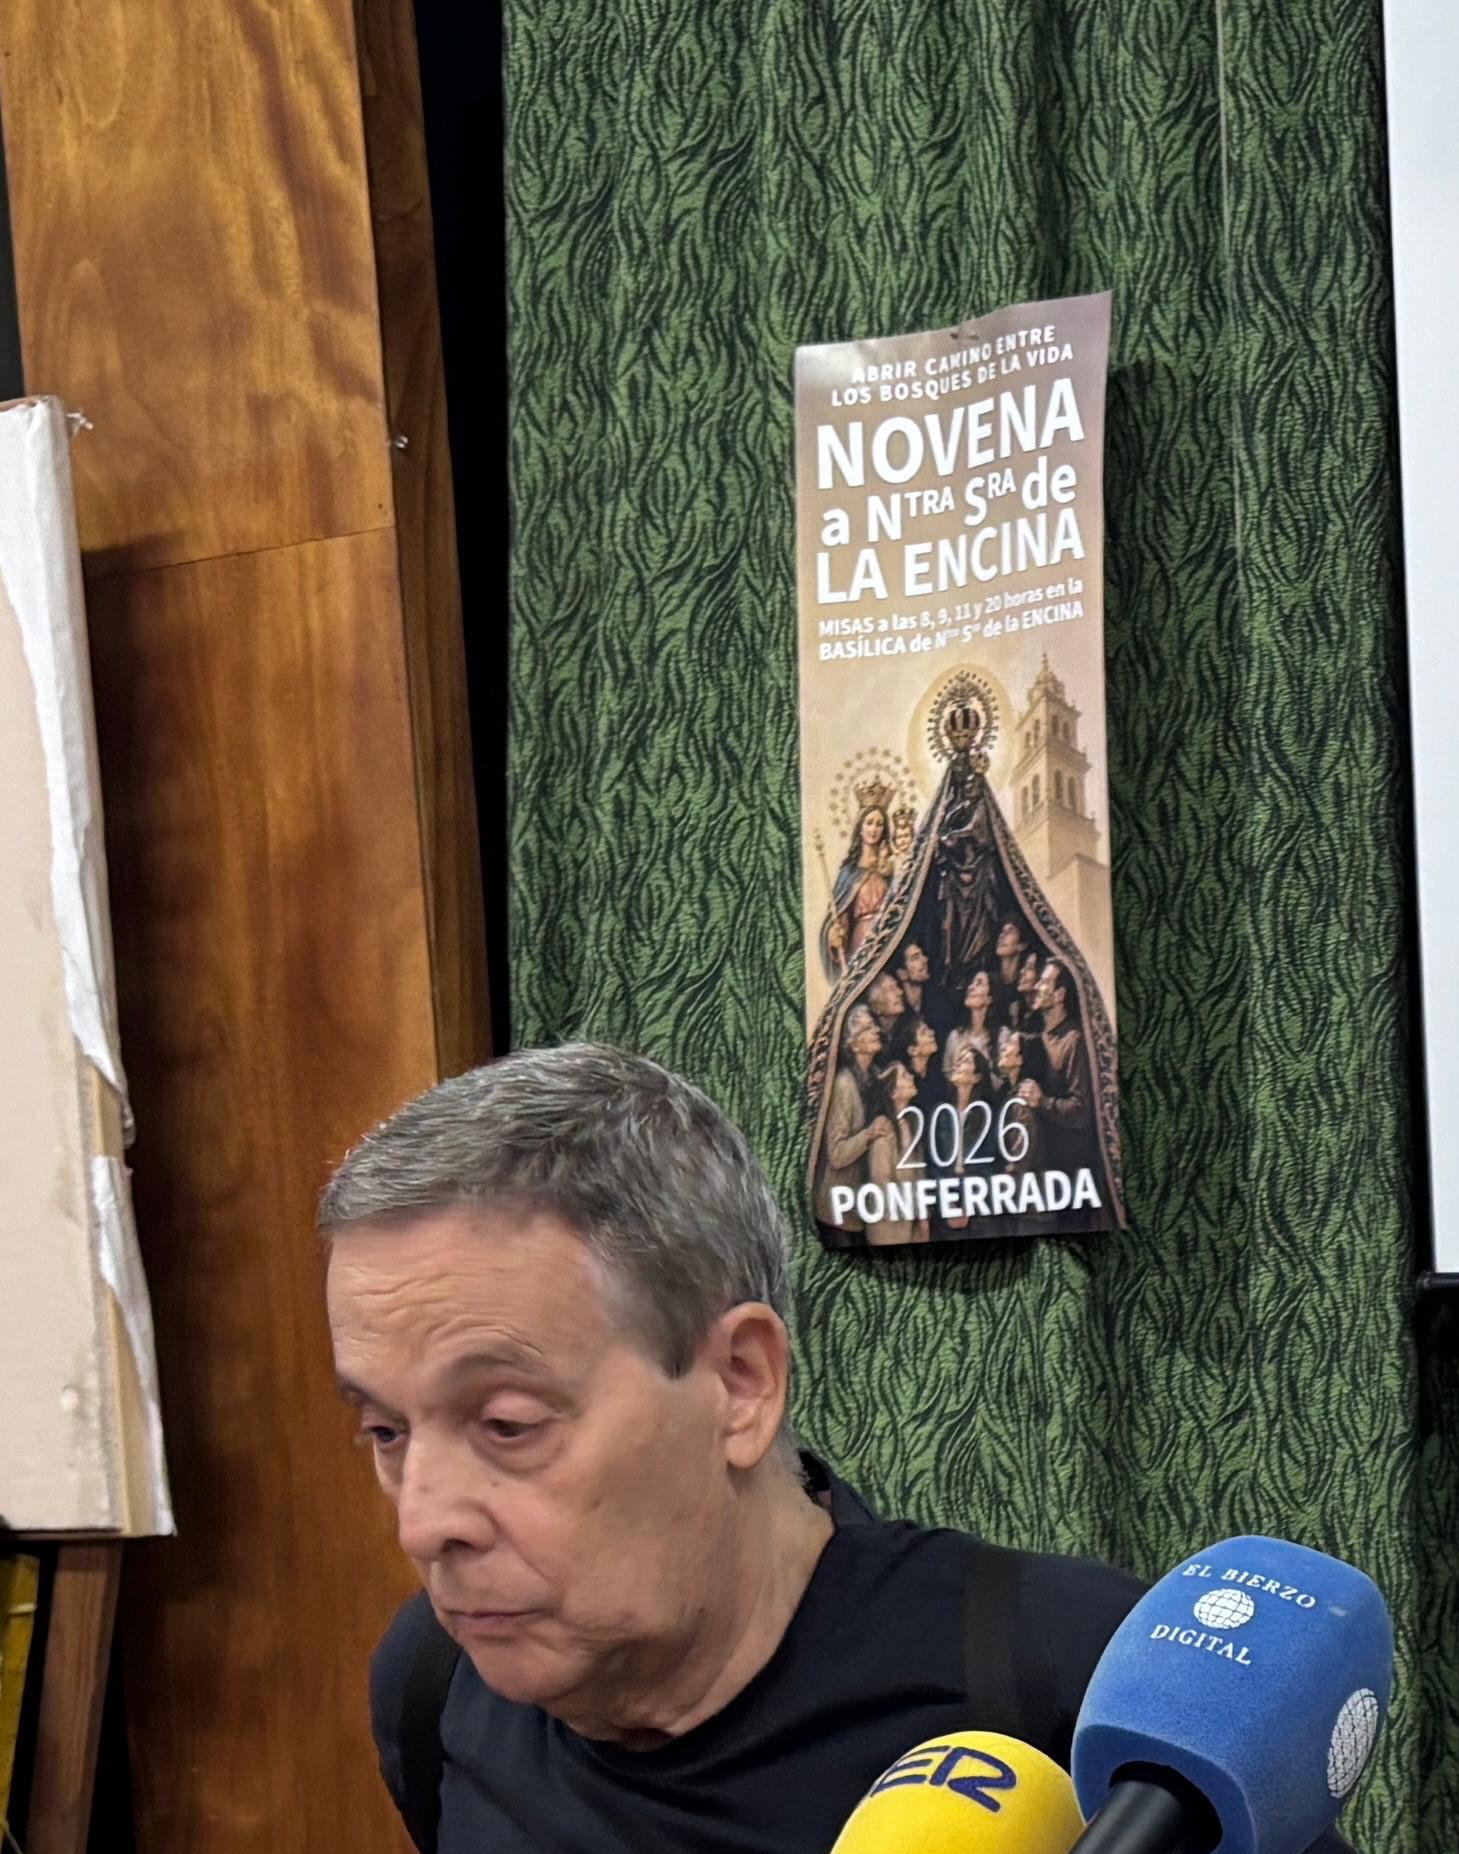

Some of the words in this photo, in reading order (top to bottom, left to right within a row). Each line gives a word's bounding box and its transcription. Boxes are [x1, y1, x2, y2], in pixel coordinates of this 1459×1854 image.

[832, 386, 872, 407] LOS
[880, 371, 974, 402] BOSQUES
[977, 362, 997, 384] DE
[1001, 354, 1022, 375] LA
[1027, 343, 1073, 368] VIDA
[852, 360, 917, 384] ABRIR
[925, 343, 992, 376] CAMINO
[996, 325, 1055, 355] ENTRE
[816, 377, 1085, 490] NOVENA
[821, 508, 850, 546] a
[1022, 456, 1077, 511] de
[816, 548, 889, 604] LA
[904, 507, 1085, 597] ENCINA
[819, 617, 874, 638] MISAS
[878, 620, 889, 632] a
[892, 613, 917, 630] las
[954, 603, 971, 622] 11
[1004, 586, 1043, 610] horas
[1046, 584, 1065, 599] en
[1068, 577, 1083, 595] la
[819, 631, 907, 661] BASÍLICA
[910, 632, 932, 652] de
[983, 620, 1002, 638] de
[1005, 614, 1019, 632] la
[1022, 601, 1084, 630] ENCINA
[896, 1099, 1029, 1170] 2026
[830, 1168, 1102, 1227] PONFERRADA
[1182, 1562, 1213, 1579] EL
[1222, 1566, 1318, 1611] BIERZO
[1150, 1623, 1253, 1667] DIGITAL
